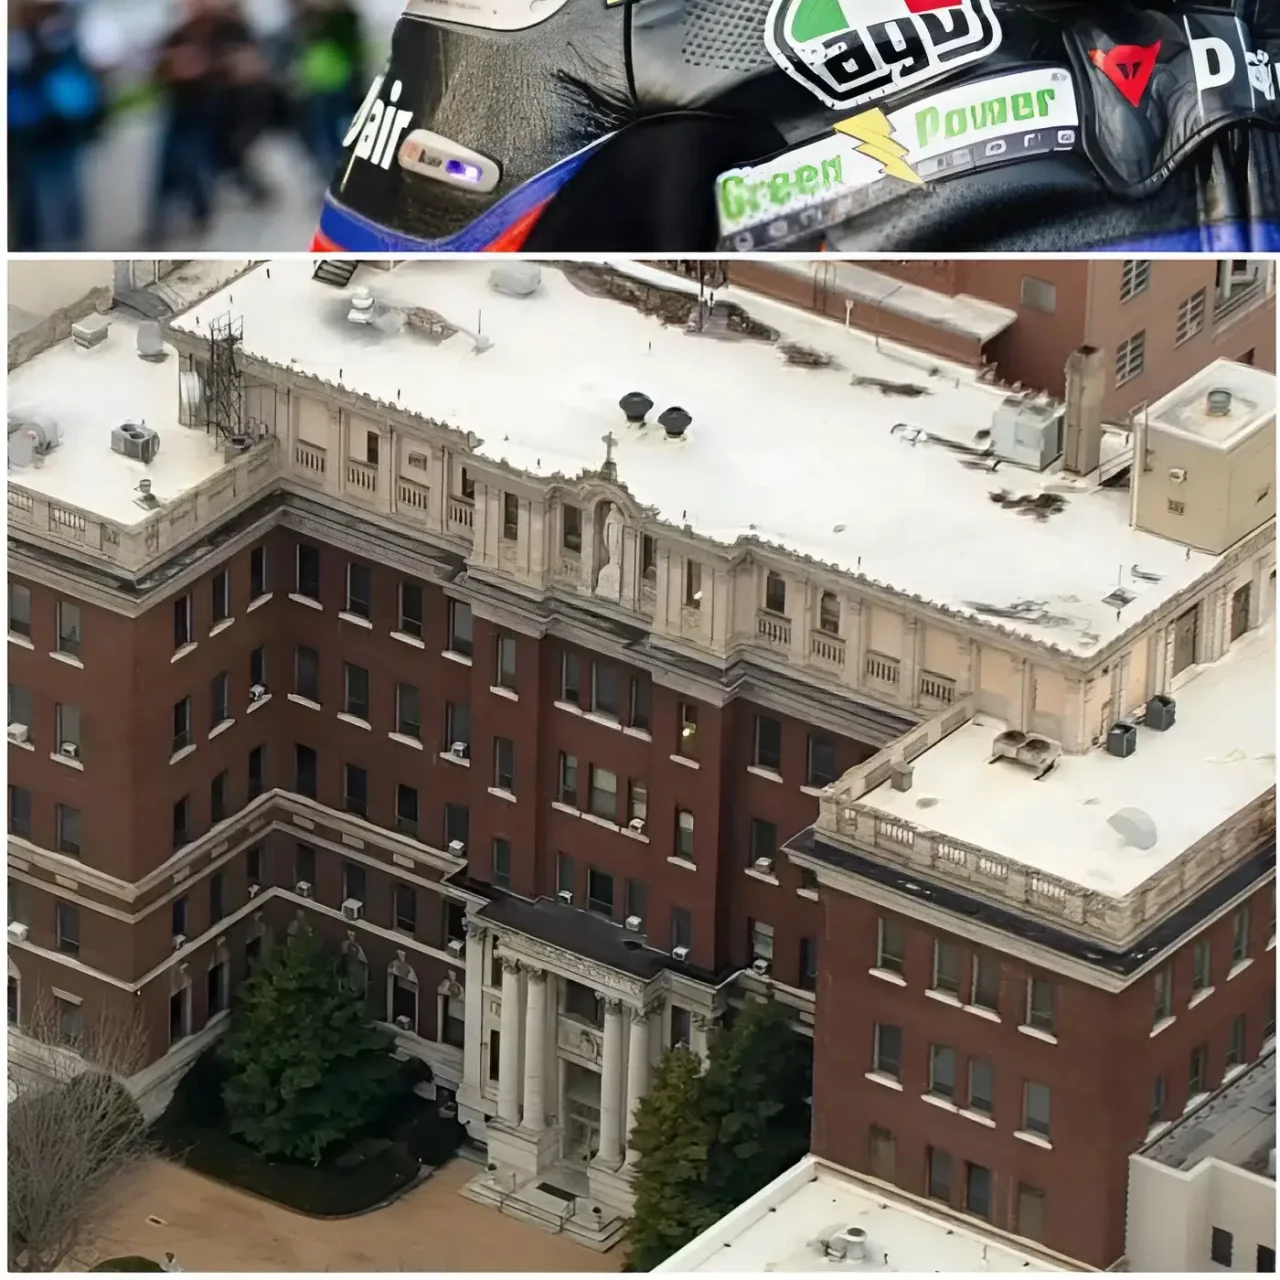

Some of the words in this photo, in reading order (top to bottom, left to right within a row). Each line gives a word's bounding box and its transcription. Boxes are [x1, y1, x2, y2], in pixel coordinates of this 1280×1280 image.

[821, 8, 970, 86] agv
[718, 154, 844, 220] Green
[915, 88, 1056, 148] Power
